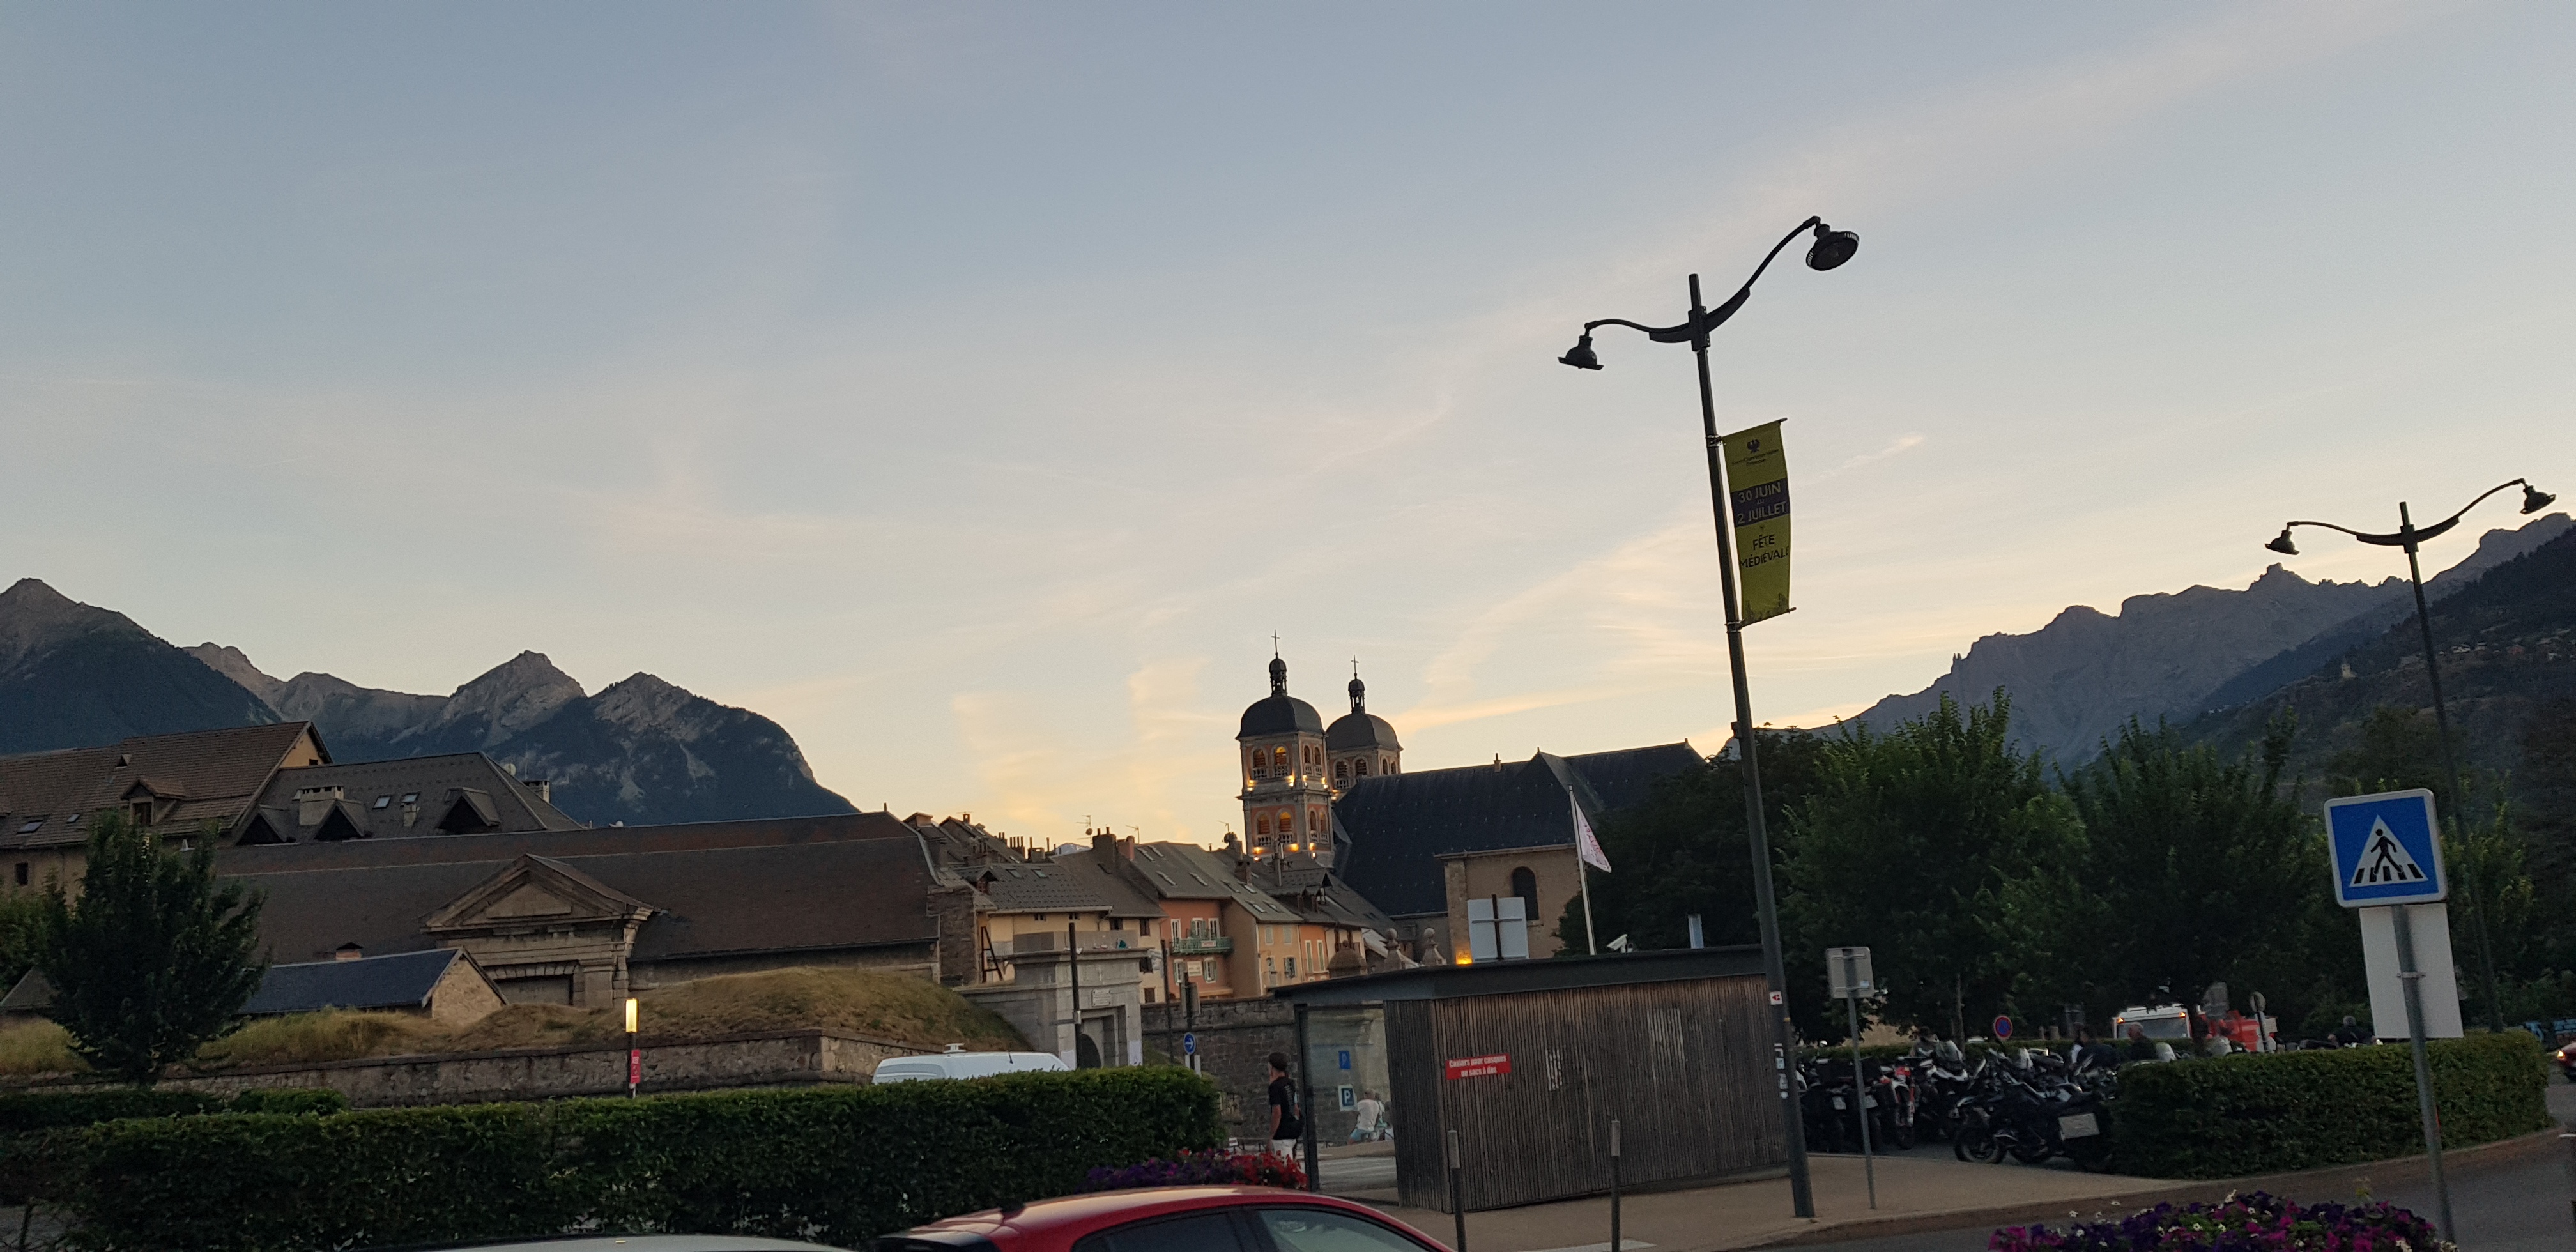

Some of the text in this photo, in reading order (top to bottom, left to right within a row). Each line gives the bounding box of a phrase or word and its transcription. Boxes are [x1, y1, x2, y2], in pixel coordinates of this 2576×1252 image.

[1738, 482, 1781, 503] 30 JUIN
[1737, 501, 1786, 524] 2 JUILLET
[1752, 534, 1775, 550] FÊTE
[1344, 1090, 1351, 1104] P
